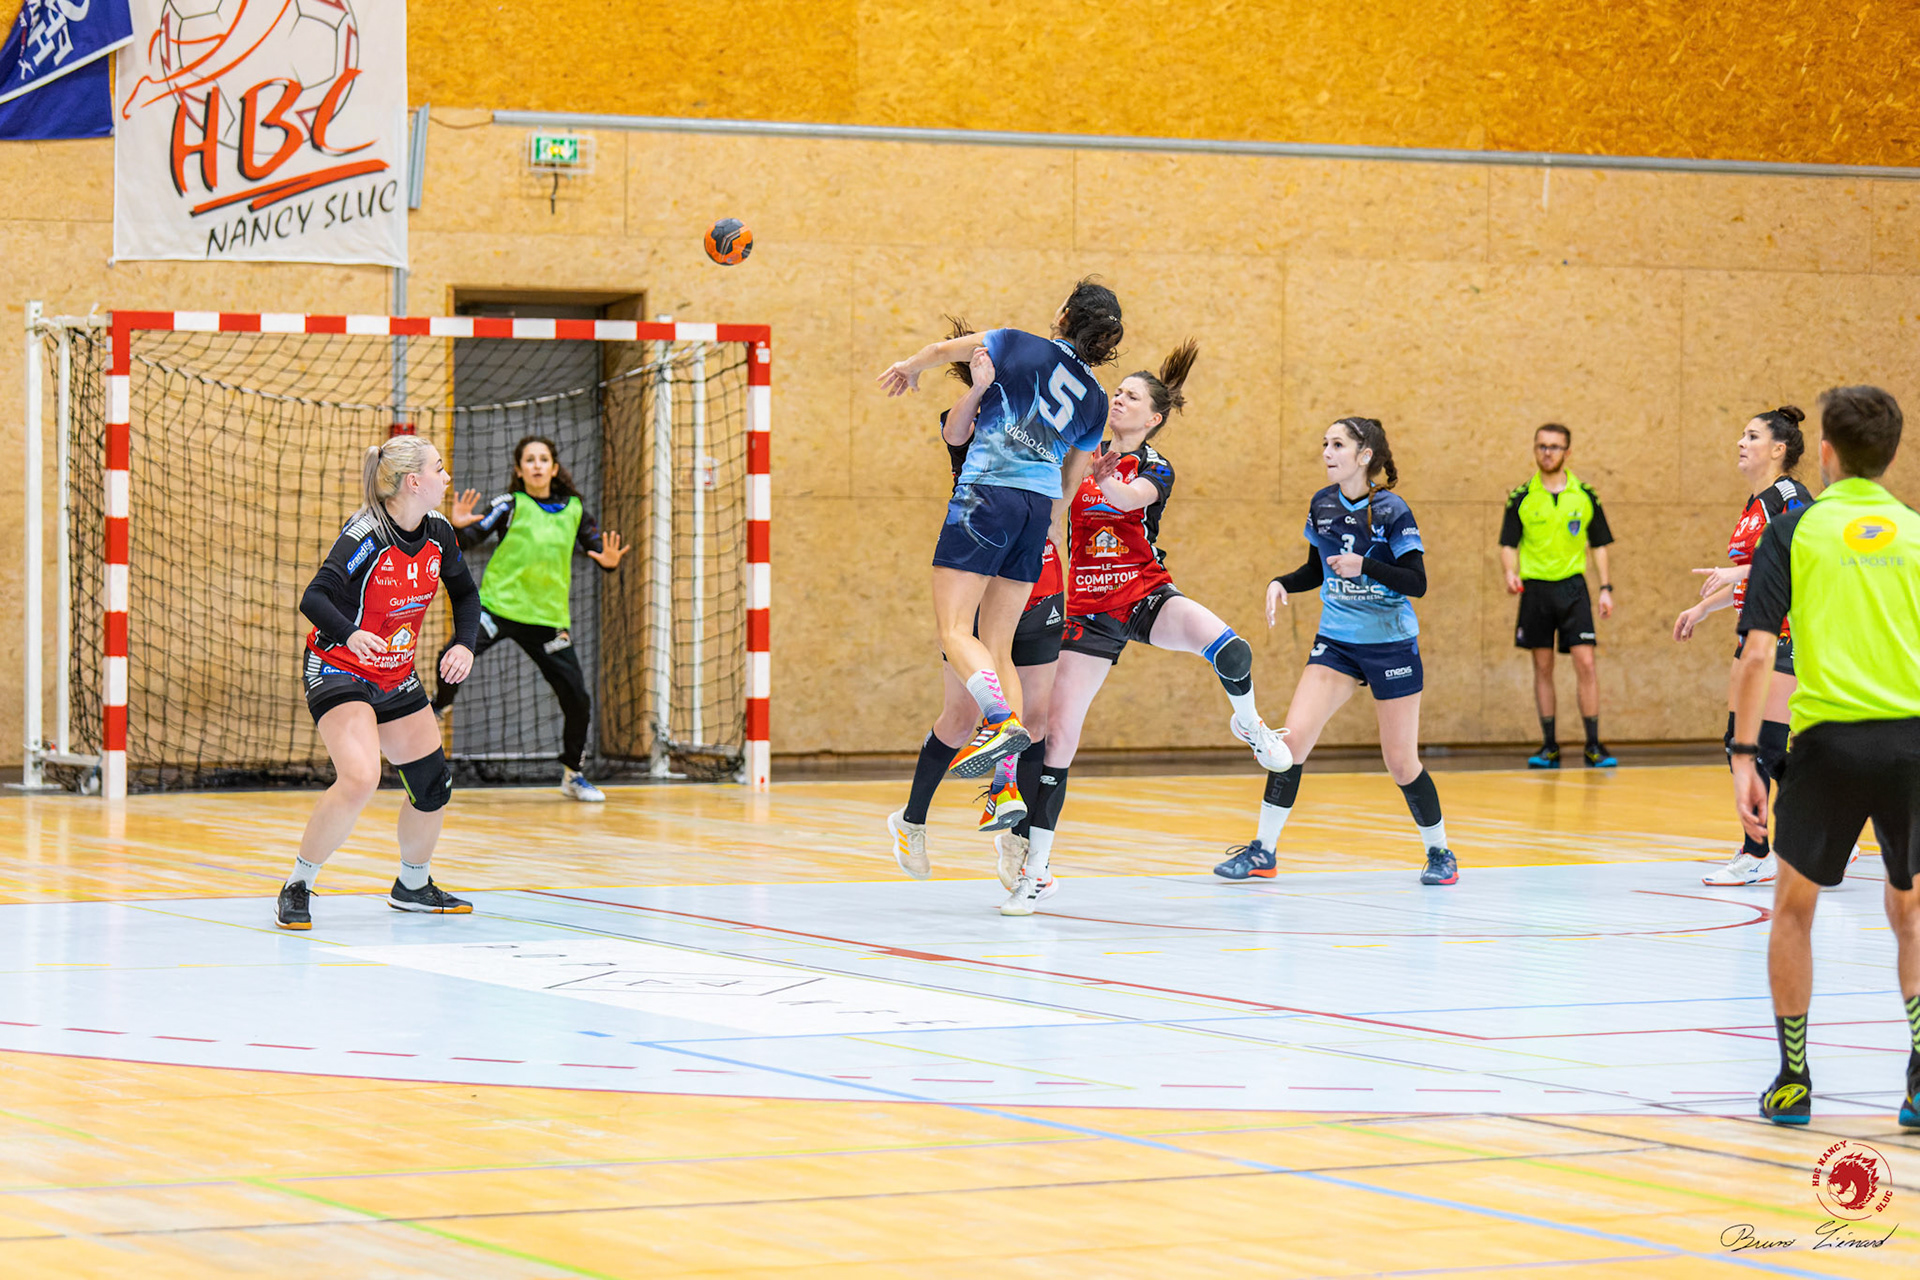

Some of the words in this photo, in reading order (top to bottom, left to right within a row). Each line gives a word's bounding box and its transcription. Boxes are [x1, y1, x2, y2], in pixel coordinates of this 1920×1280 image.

[170, 68, 377, 197] HBC
[206, 198, 312, 257] NANCY
[324, 179, 400, 231] SLUC
[1038, 361, 1088, 433] 5
[1081, 493, 1097, 505] Guy
[1340, 533, 1356, 556] 3
[1101, 563, 1112, 571] LE
[1839, 556, 1857, 567] LA
[1859, 556, 1905, 567] POSTE
[406, 562, 419, 589] 4
[389, 597, 407, 608] Guy
